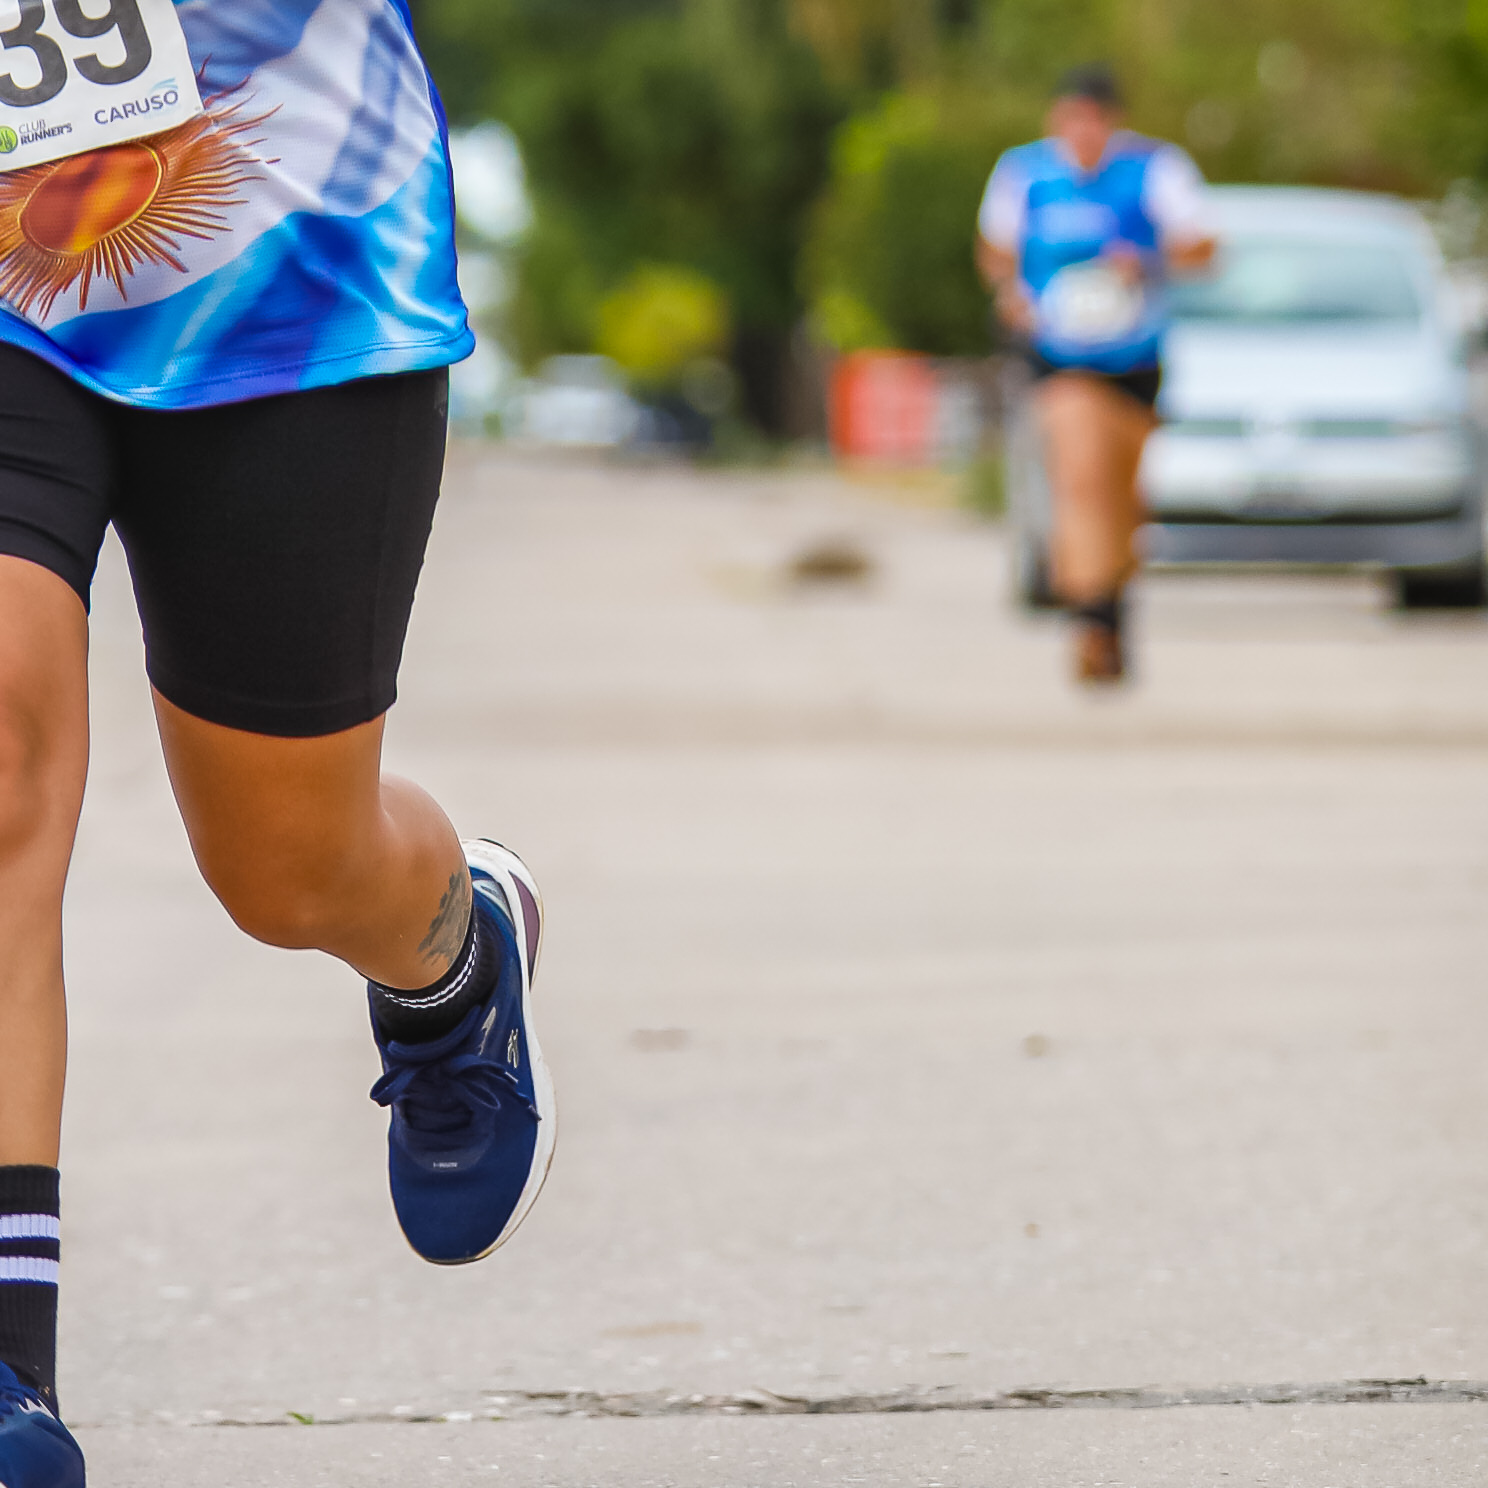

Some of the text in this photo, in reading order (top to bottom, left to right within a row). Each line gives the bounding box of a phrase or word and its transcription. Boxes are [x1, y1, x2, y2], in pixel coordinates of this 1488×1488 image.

[94, 89, 179, 125] CARUSO
[19, 119, 48, 135] CLUB
[20, 122, 73, 146] RUNNER'S
